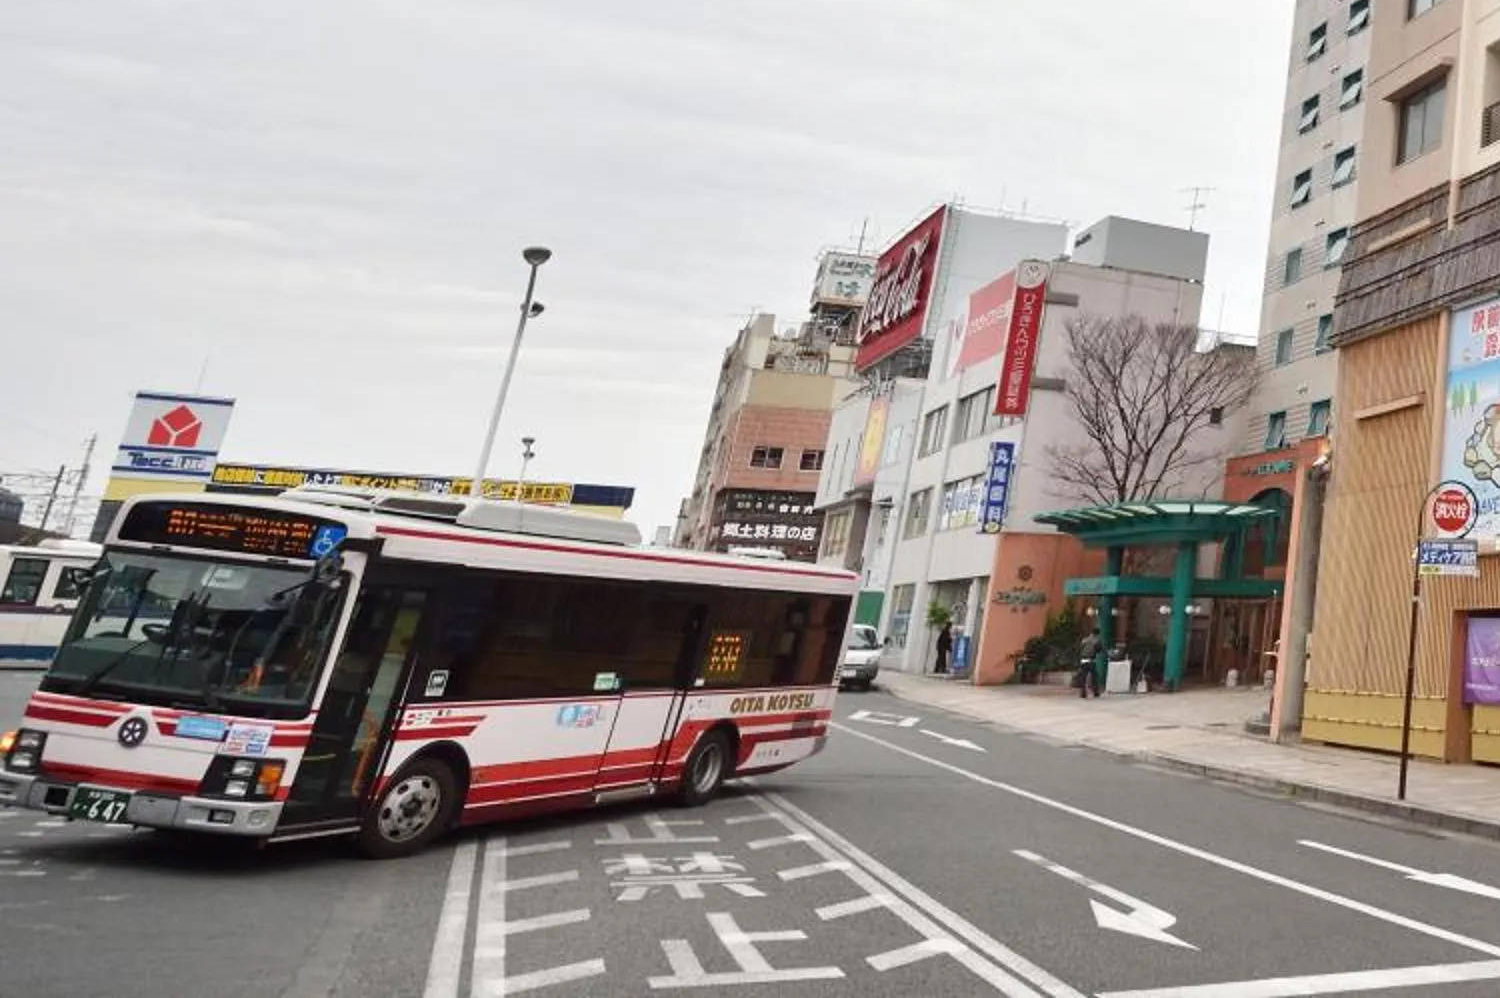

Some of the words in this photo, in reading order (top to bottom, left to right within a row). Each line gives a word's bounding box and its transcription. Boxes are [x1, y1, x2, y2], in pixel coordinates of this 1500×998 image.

[722, 522, 817, 540] 郷土料理の店
[729, 696, 764, 713] OITA
[767, 692, 815, 711] KOTSU
